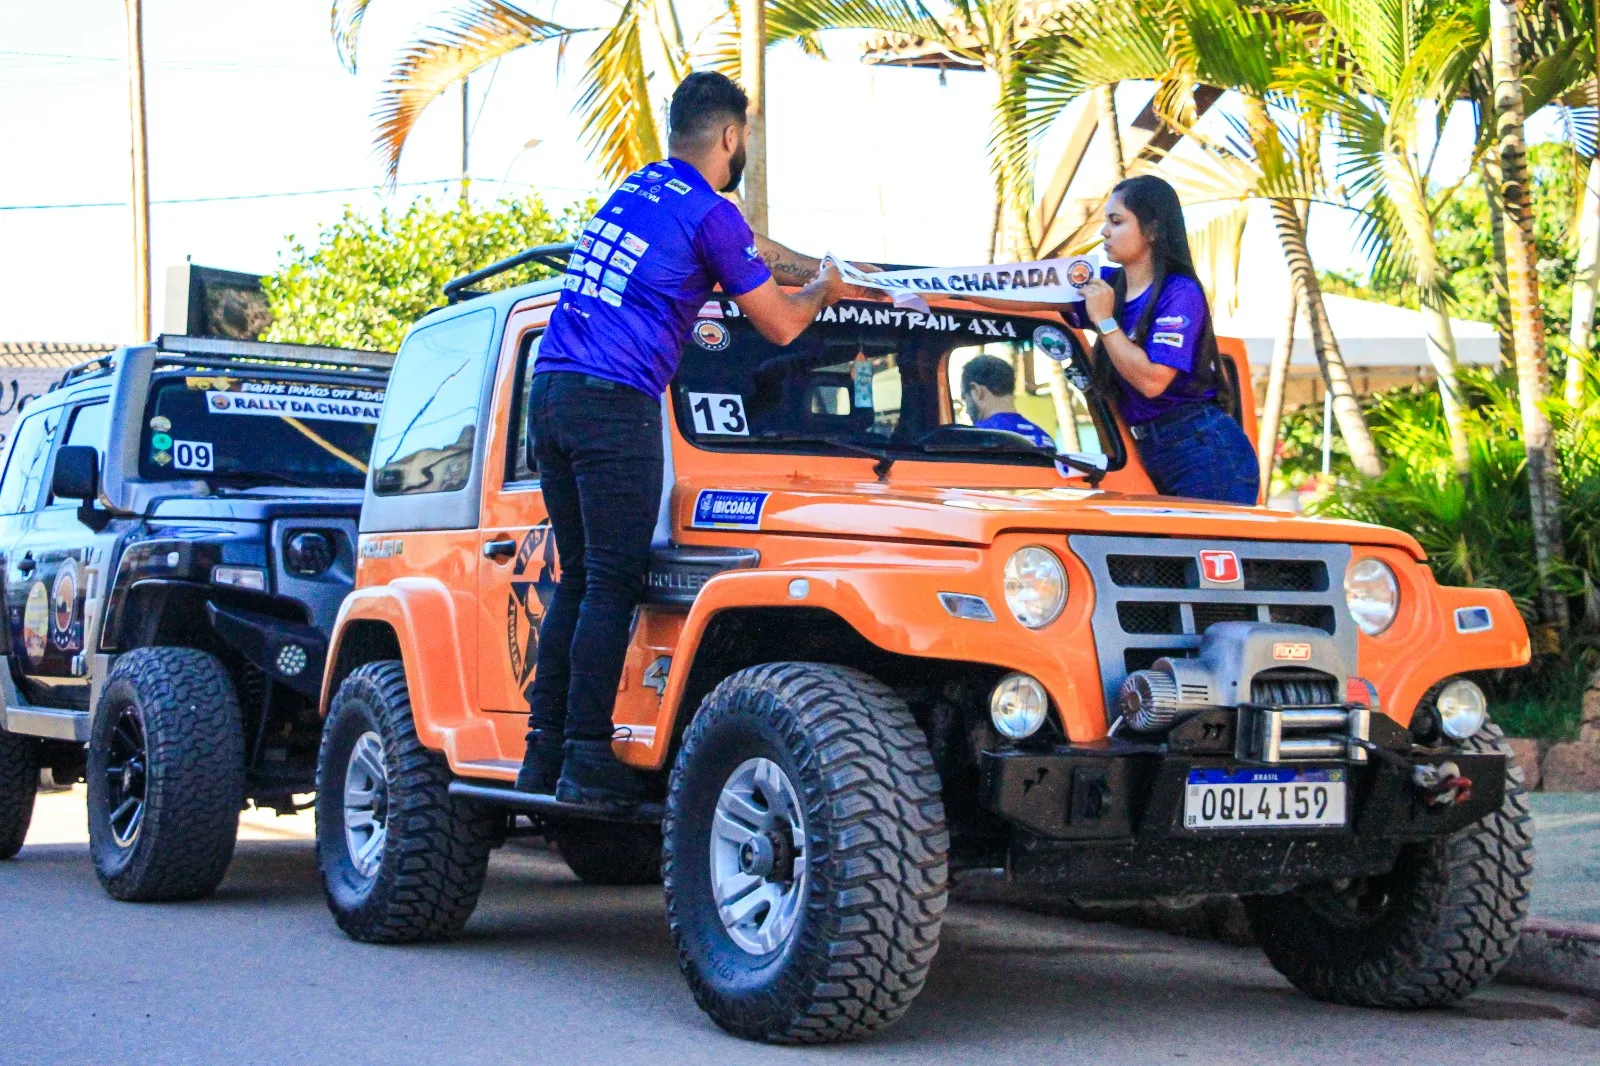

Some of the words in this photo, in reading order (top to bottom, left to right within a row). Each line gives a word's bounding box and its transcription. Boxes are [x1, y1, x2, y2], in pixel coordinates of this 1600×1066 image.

[912, 277, 950, 291] DA
[948, 266, 1062, 292] CHAPADA
[242, 382, 286, 394] EQUIPE
[331, 388, 355, 399] OFF
[235, 398, 287, 411] RALLY
[290, 401, 315, 413] DA
[694, 397, 745, 433] 13
[177, 443, 211, 468] 09
[712, 500, 757, 515] IBICOARA
[1253, 773, 1279, 781] BRASIL
